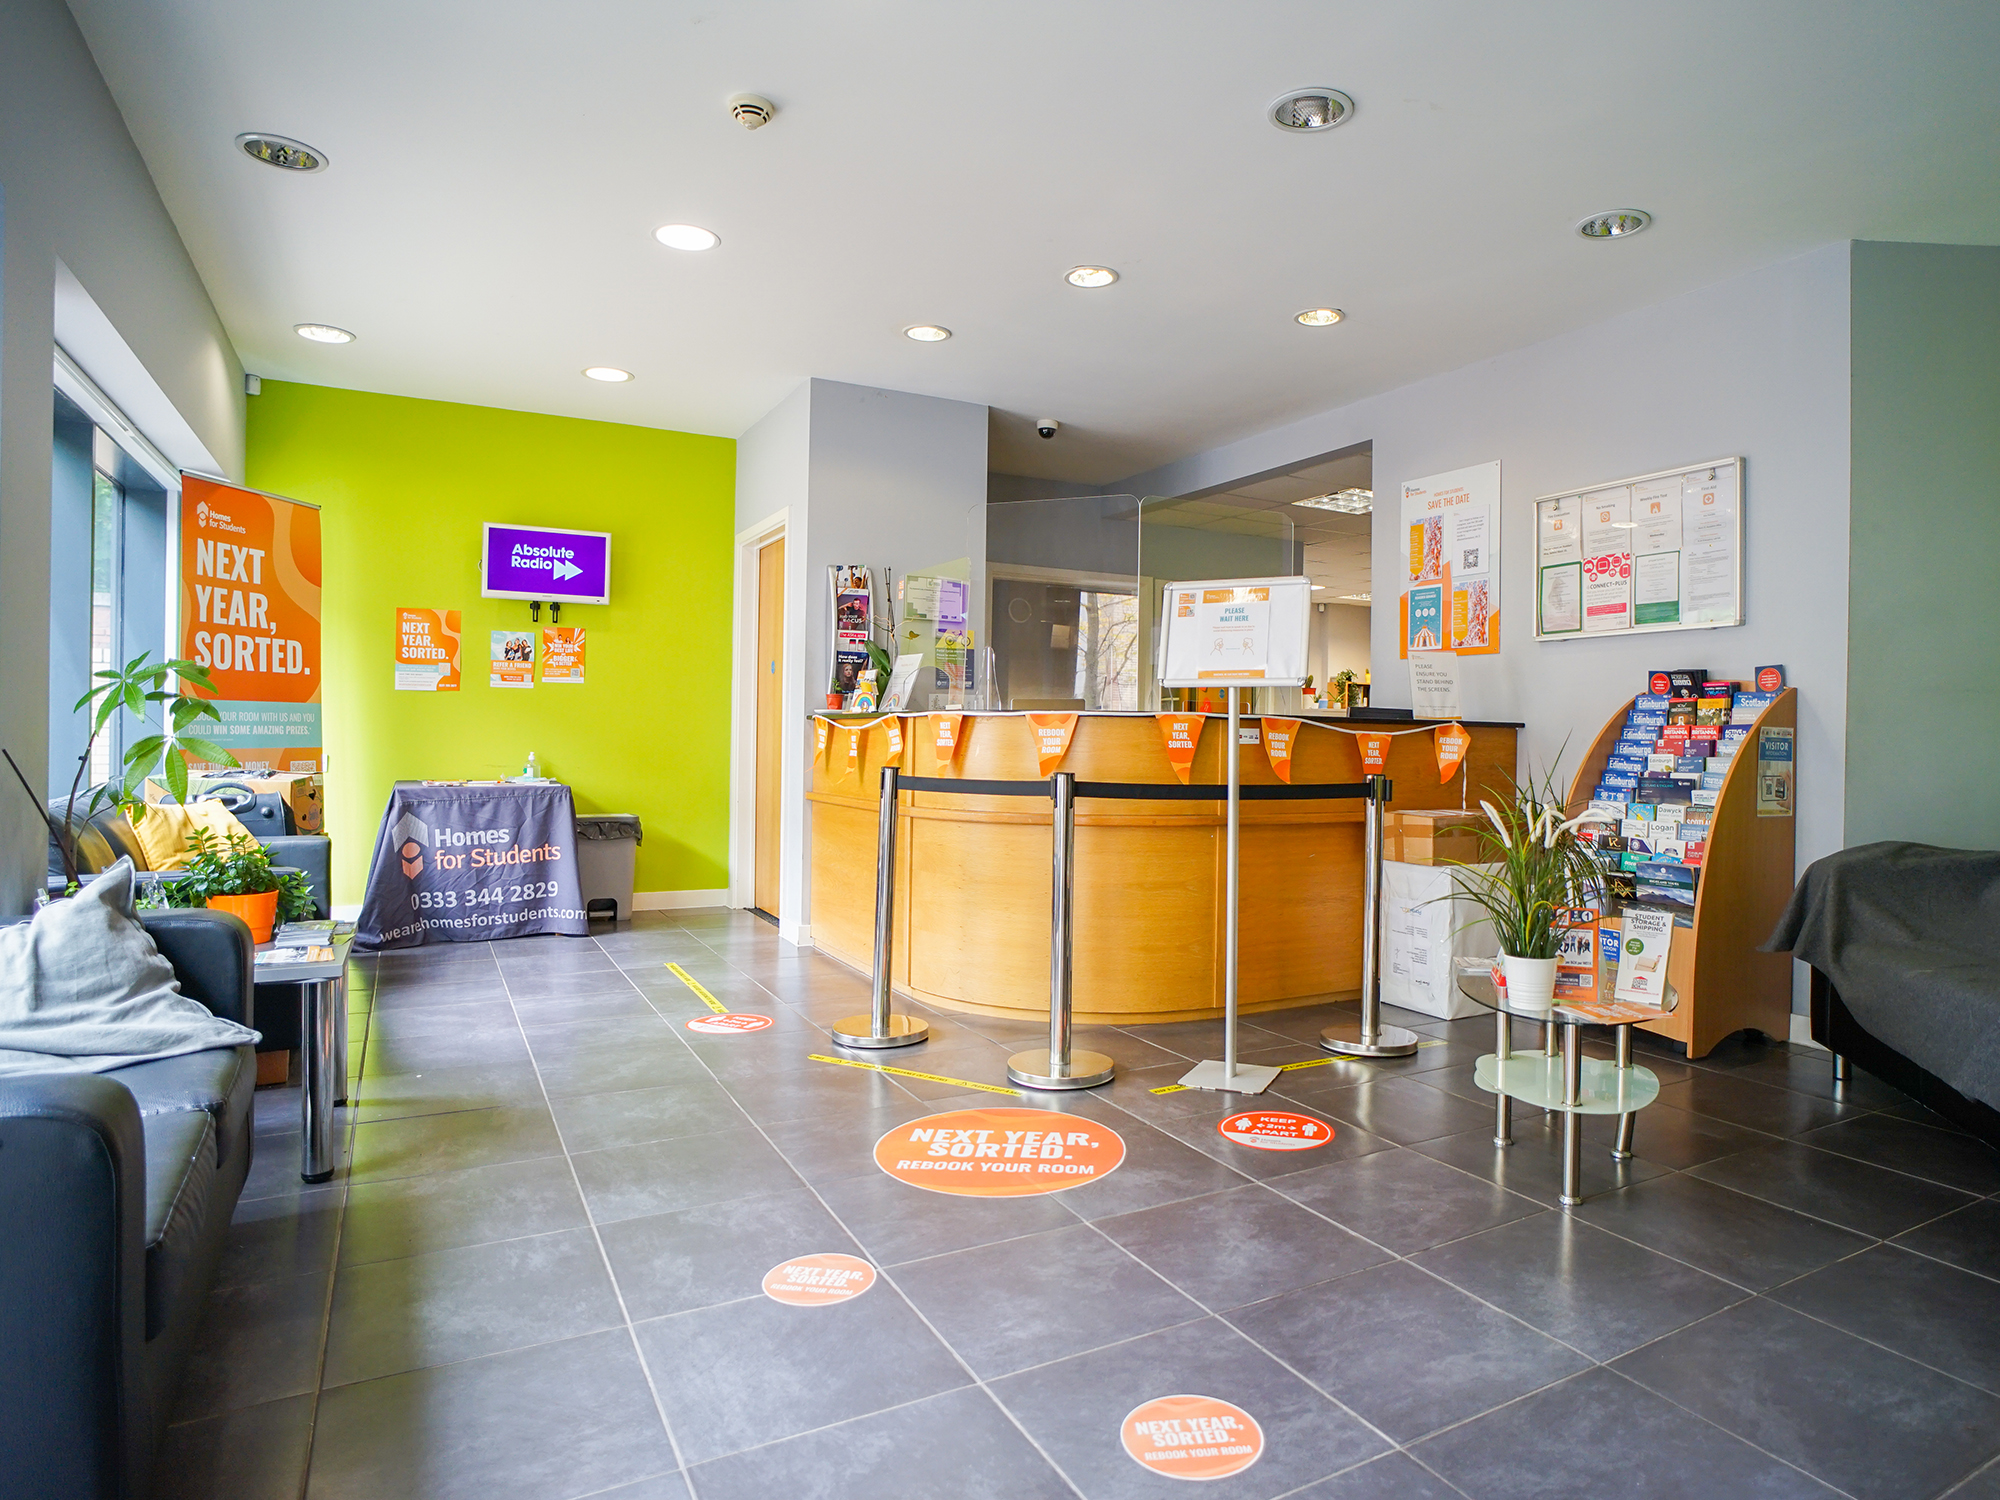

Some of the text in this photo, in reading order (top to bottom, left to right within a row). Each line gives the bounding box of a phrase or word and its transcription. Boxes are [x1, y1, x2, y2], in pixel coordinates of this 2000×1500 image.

[1427, 493, 1470, 510] SAVE THE DATE
[209, 510, 231, 522] Homes
[209, 519, 246, 534] for Students
[512, 543, 574, 559] Absolute
[196, 537, 265, 585] NEXT
[511, 555, 553, 570] Radio
[195, 584, 277, 635] YEAR,
[402, 621, 430, 634] NEXT
[402, 635, 435, 648] YEAR,
[195, 631, 310, 675] SORTED.
[402, 647, 449, 659] SORTED.
[1639, 700, 1669, 709] Edinburgh
[1741, 698, 1770, 707] Scotland
[220, 711, 238, 722] YOUR
[239, 711, 259, 722] ROOM
[261, 712, 278, 722] WITH
[279, 712, 288, 722] US
[289, 712, 302, 722] AND
[303, 713, 315, 722] YOU
[1634, 715, 1664, 724] Edinburgh
[188, 724, 211, 735] COULD
[213, 725, 228, 735] WIN
[230, 725, 250, 735] SOME
[252, 725, 284, 735] AMAZING
[1038, 728, 1065, 736] REBOOK
[1173, 723, 1189, 731] NEXT
[939, 730, 952, 738] YEAR,
[1172, 732, 1190, 740] YEAR,
[1268, 732, 1289, 741] REBOOK
[1043, 737, 1060, 745] YOUR
[1168, 740, 1194, 748] SORTED.
[1271, 741, 1285, 749] YOUR
[1439, 737, 1463, 745] REBOOK
[1765, 741, 1789, 750] VISITOR
[1367, 749, 1380, 757] YEAR,
[1440, 752, 1458, 760] ROOM
[1610, 760, 1641, 771] Edimburgo
[1606, 776, 1635, 786] Edinburgh
[1659, 806, 1682, 814] Dawyck
[1651, 823, 1674, 832] Logan
[434, 828, 510, 848] Homes
[434, 844, 561, 870] for Students
[410, 880, 559, 911] 0333 344 2829
[1585, 912, 1590, 921] 1
[1635, 913, 1664, 921] STUDENT
[380, 906, 588, 943] wearehomesforstudents.com
[1631, 918, 1660, 927] STORAGE
[1633, 924, 1663, 932] SHIPPING
[1260, 1116, 1297, 1124] KEEP
[909, 1128, 1100, 1149] NEXT YEAR,
[1251, 1129, 1298, 1137] APART
[927, 1142, 1073, 1159] SORTED.
[896, 1160, 1094, 1175] REBOOK YOUR ROOM
[782, 1265, 864, 1281] NEXT YEAR,
[786, 1273, 848, 1287] SORTED.
[770, 1283, 854, 1296] REBOOK YOUR ROOM
[1134, 1415, 1244, 1436] NEXT YEAR,
[1152, 1429, 1236, 1447] SORTED.
[1144, 1444, 1253, 1461] REBOOK YOUR ROOM
